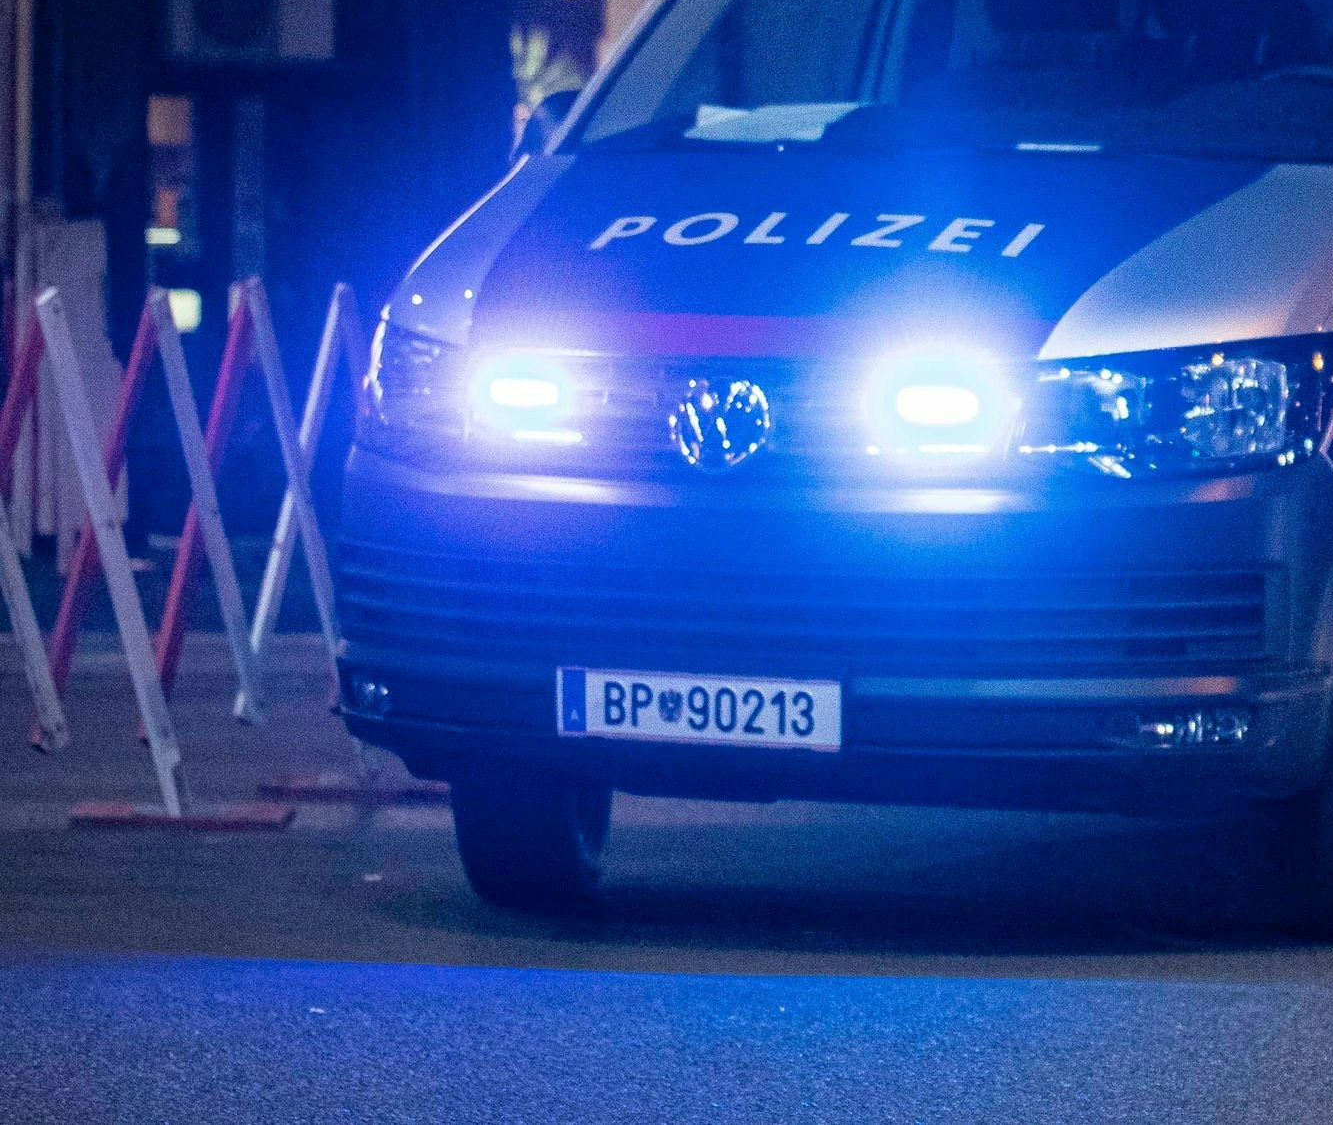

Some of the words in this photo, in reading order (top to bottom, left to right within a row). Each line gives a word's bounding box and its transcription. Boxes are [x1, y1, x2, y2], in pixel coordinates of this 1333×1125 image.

[589, 211, 1046, 258] POLIZEI
[604, 680, 653, 726] BP
[687, 685, 815, 737] 90213
